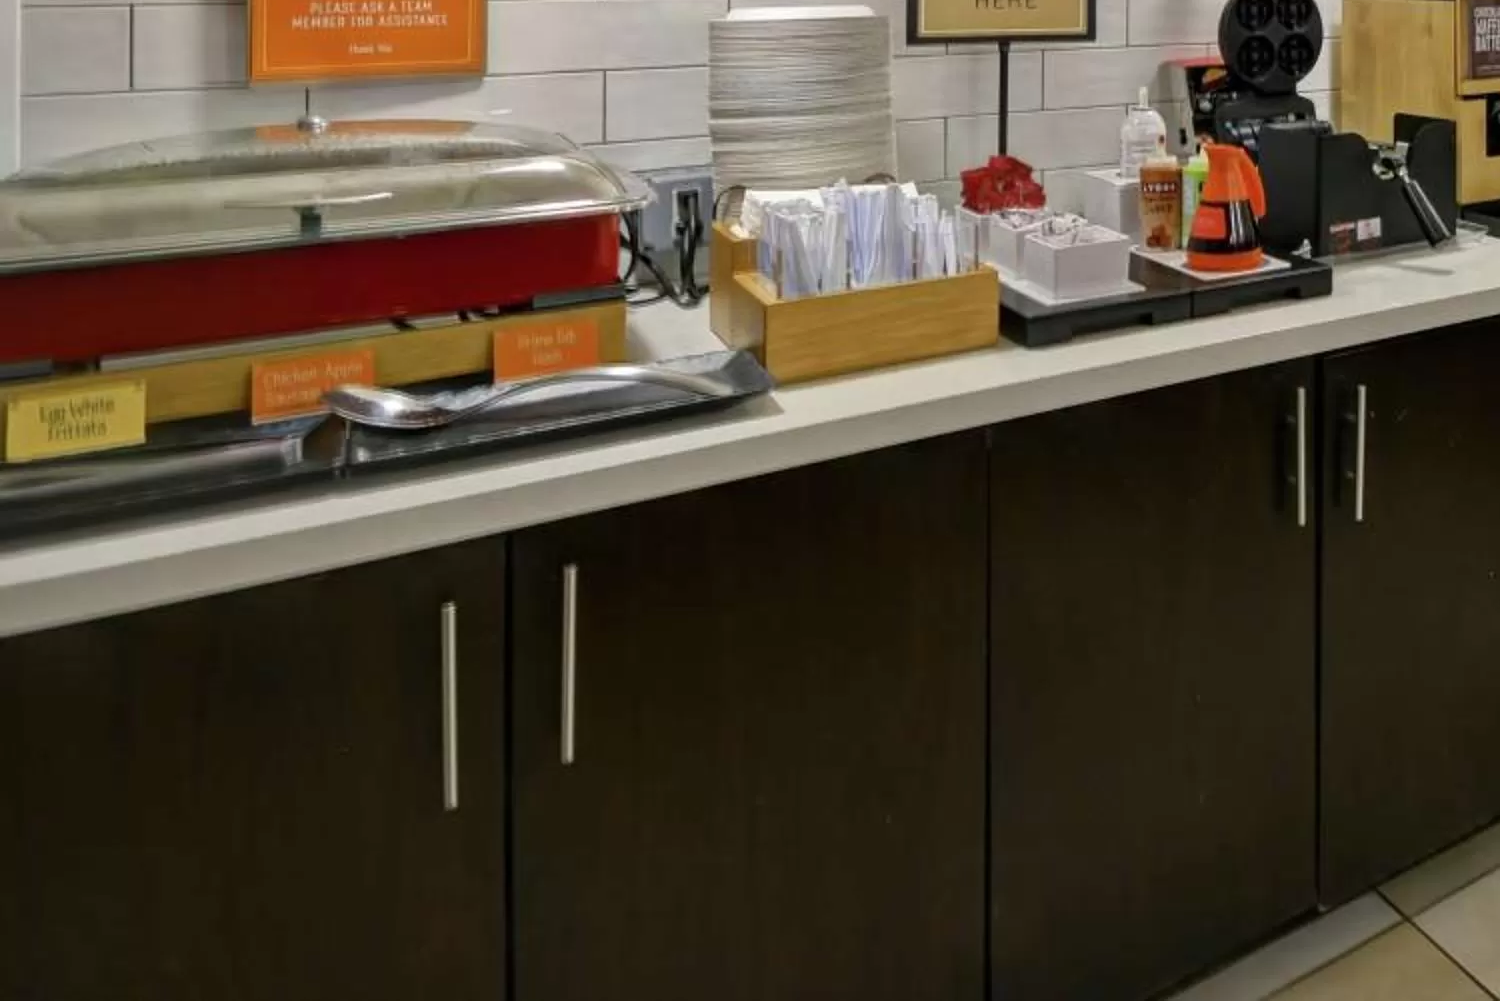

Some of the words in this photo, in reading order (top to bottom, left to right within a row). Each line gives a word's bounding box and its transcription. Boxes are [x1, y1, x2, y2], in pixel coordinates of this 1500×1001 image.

[310, 0, 355, 14] PLEASE
[400, 0, 433, 12] TEAM
[292, 15, 345, 29] MEMBER
[378, 14, 448, 27] ASSISTANCE
